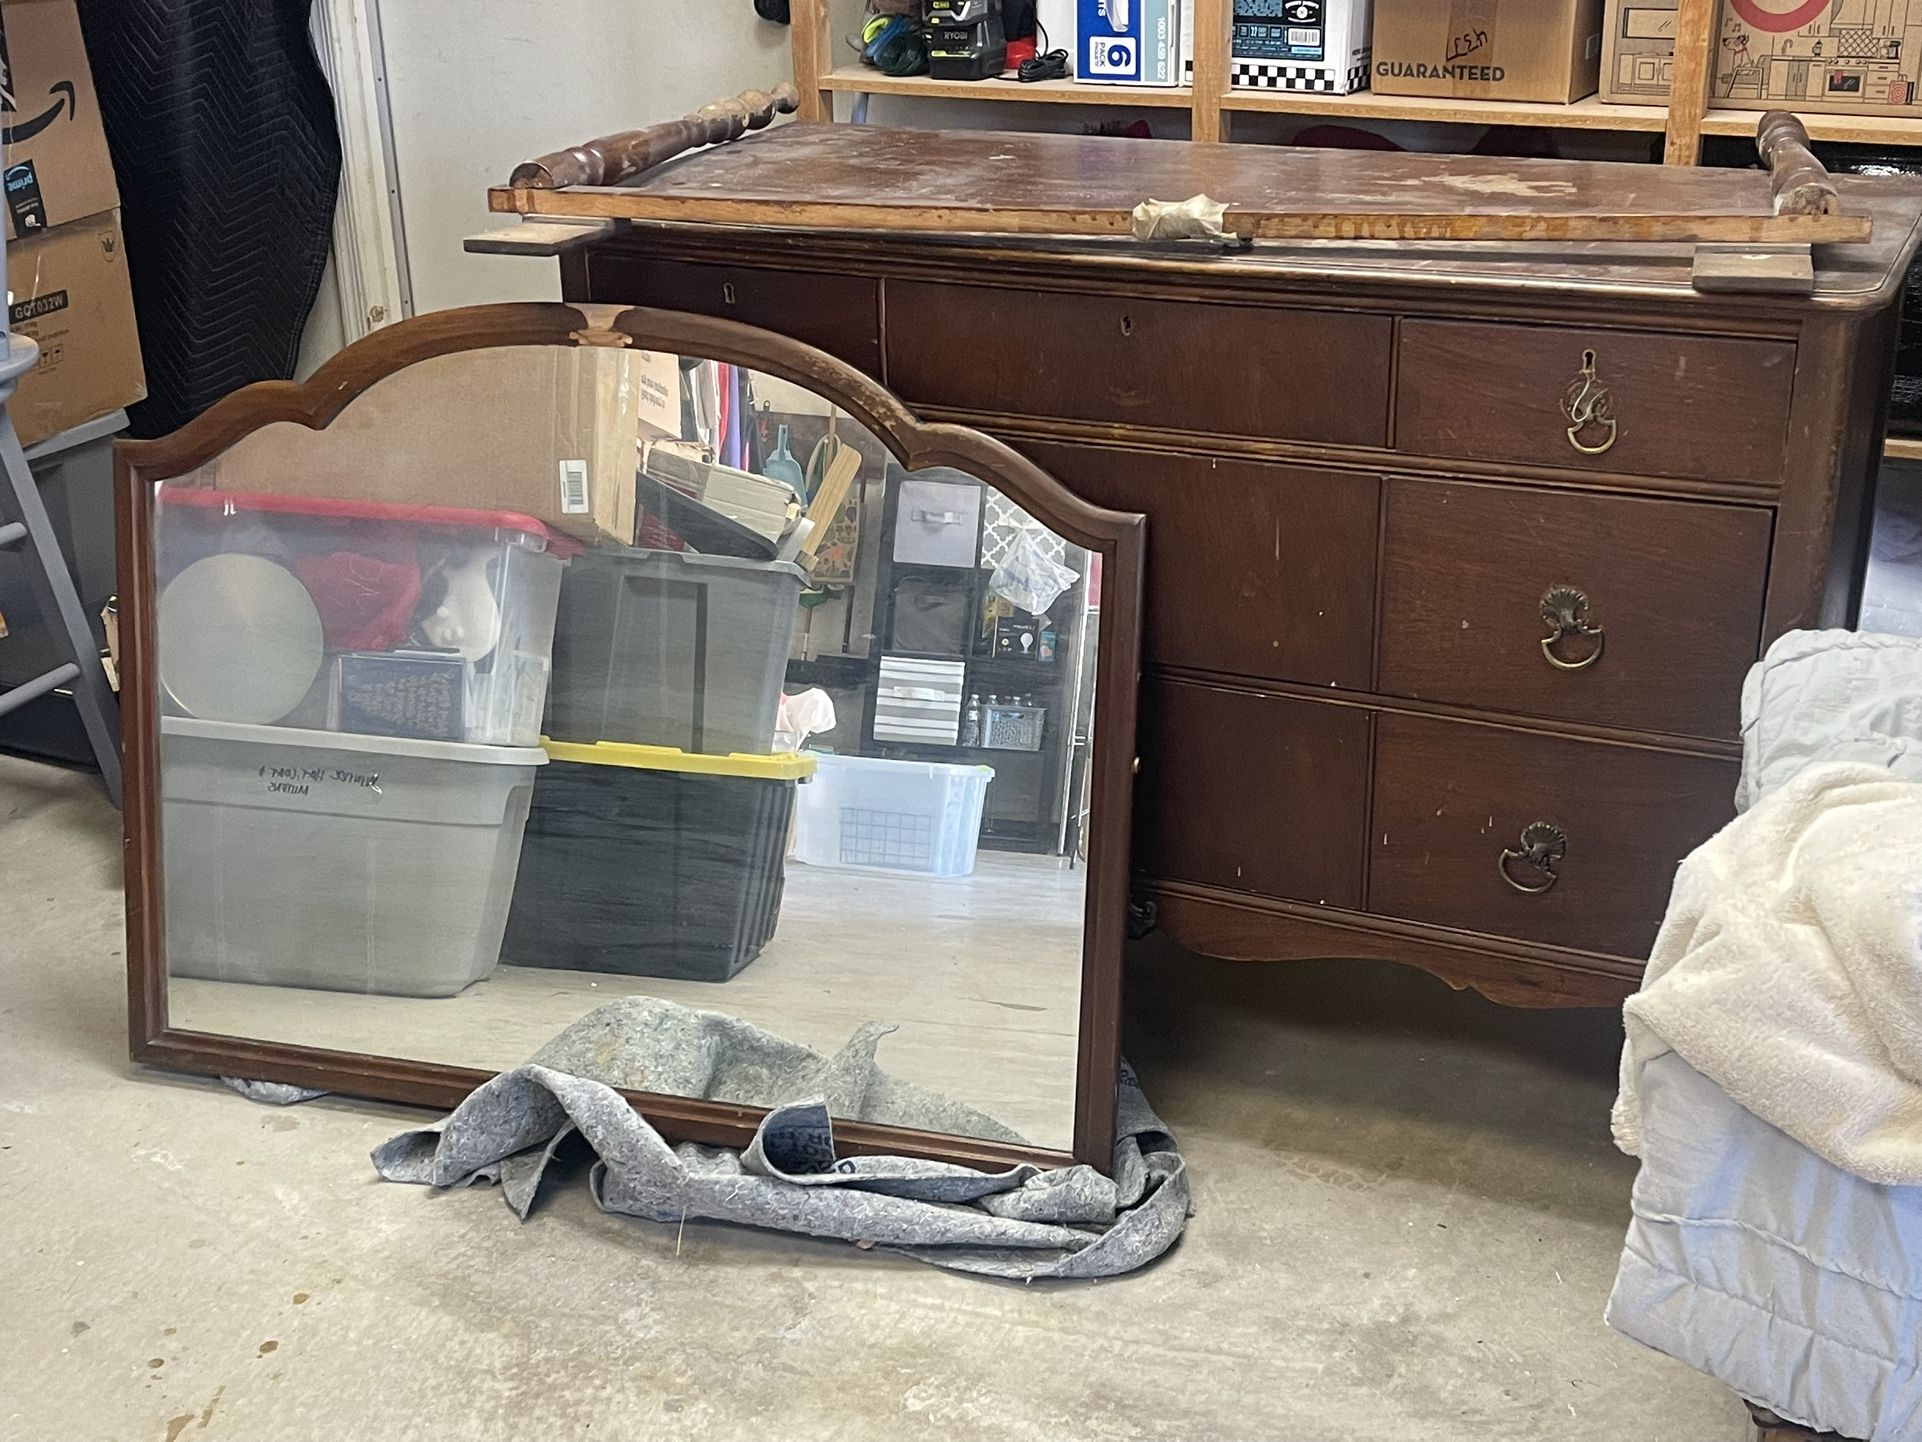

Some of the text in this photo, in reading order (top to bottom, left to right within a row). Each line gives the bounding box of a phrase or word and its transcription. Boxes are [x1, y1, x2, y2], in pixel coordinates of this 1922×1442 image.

[943, 31, 968, 40] RYOBI
[1099, 42, 1107, 67] PACK
[1107, 44, 1131, 68] 6
[1375, 61, 1506, 82] GUARANTEED
[6, 171, 34, 192] prime
